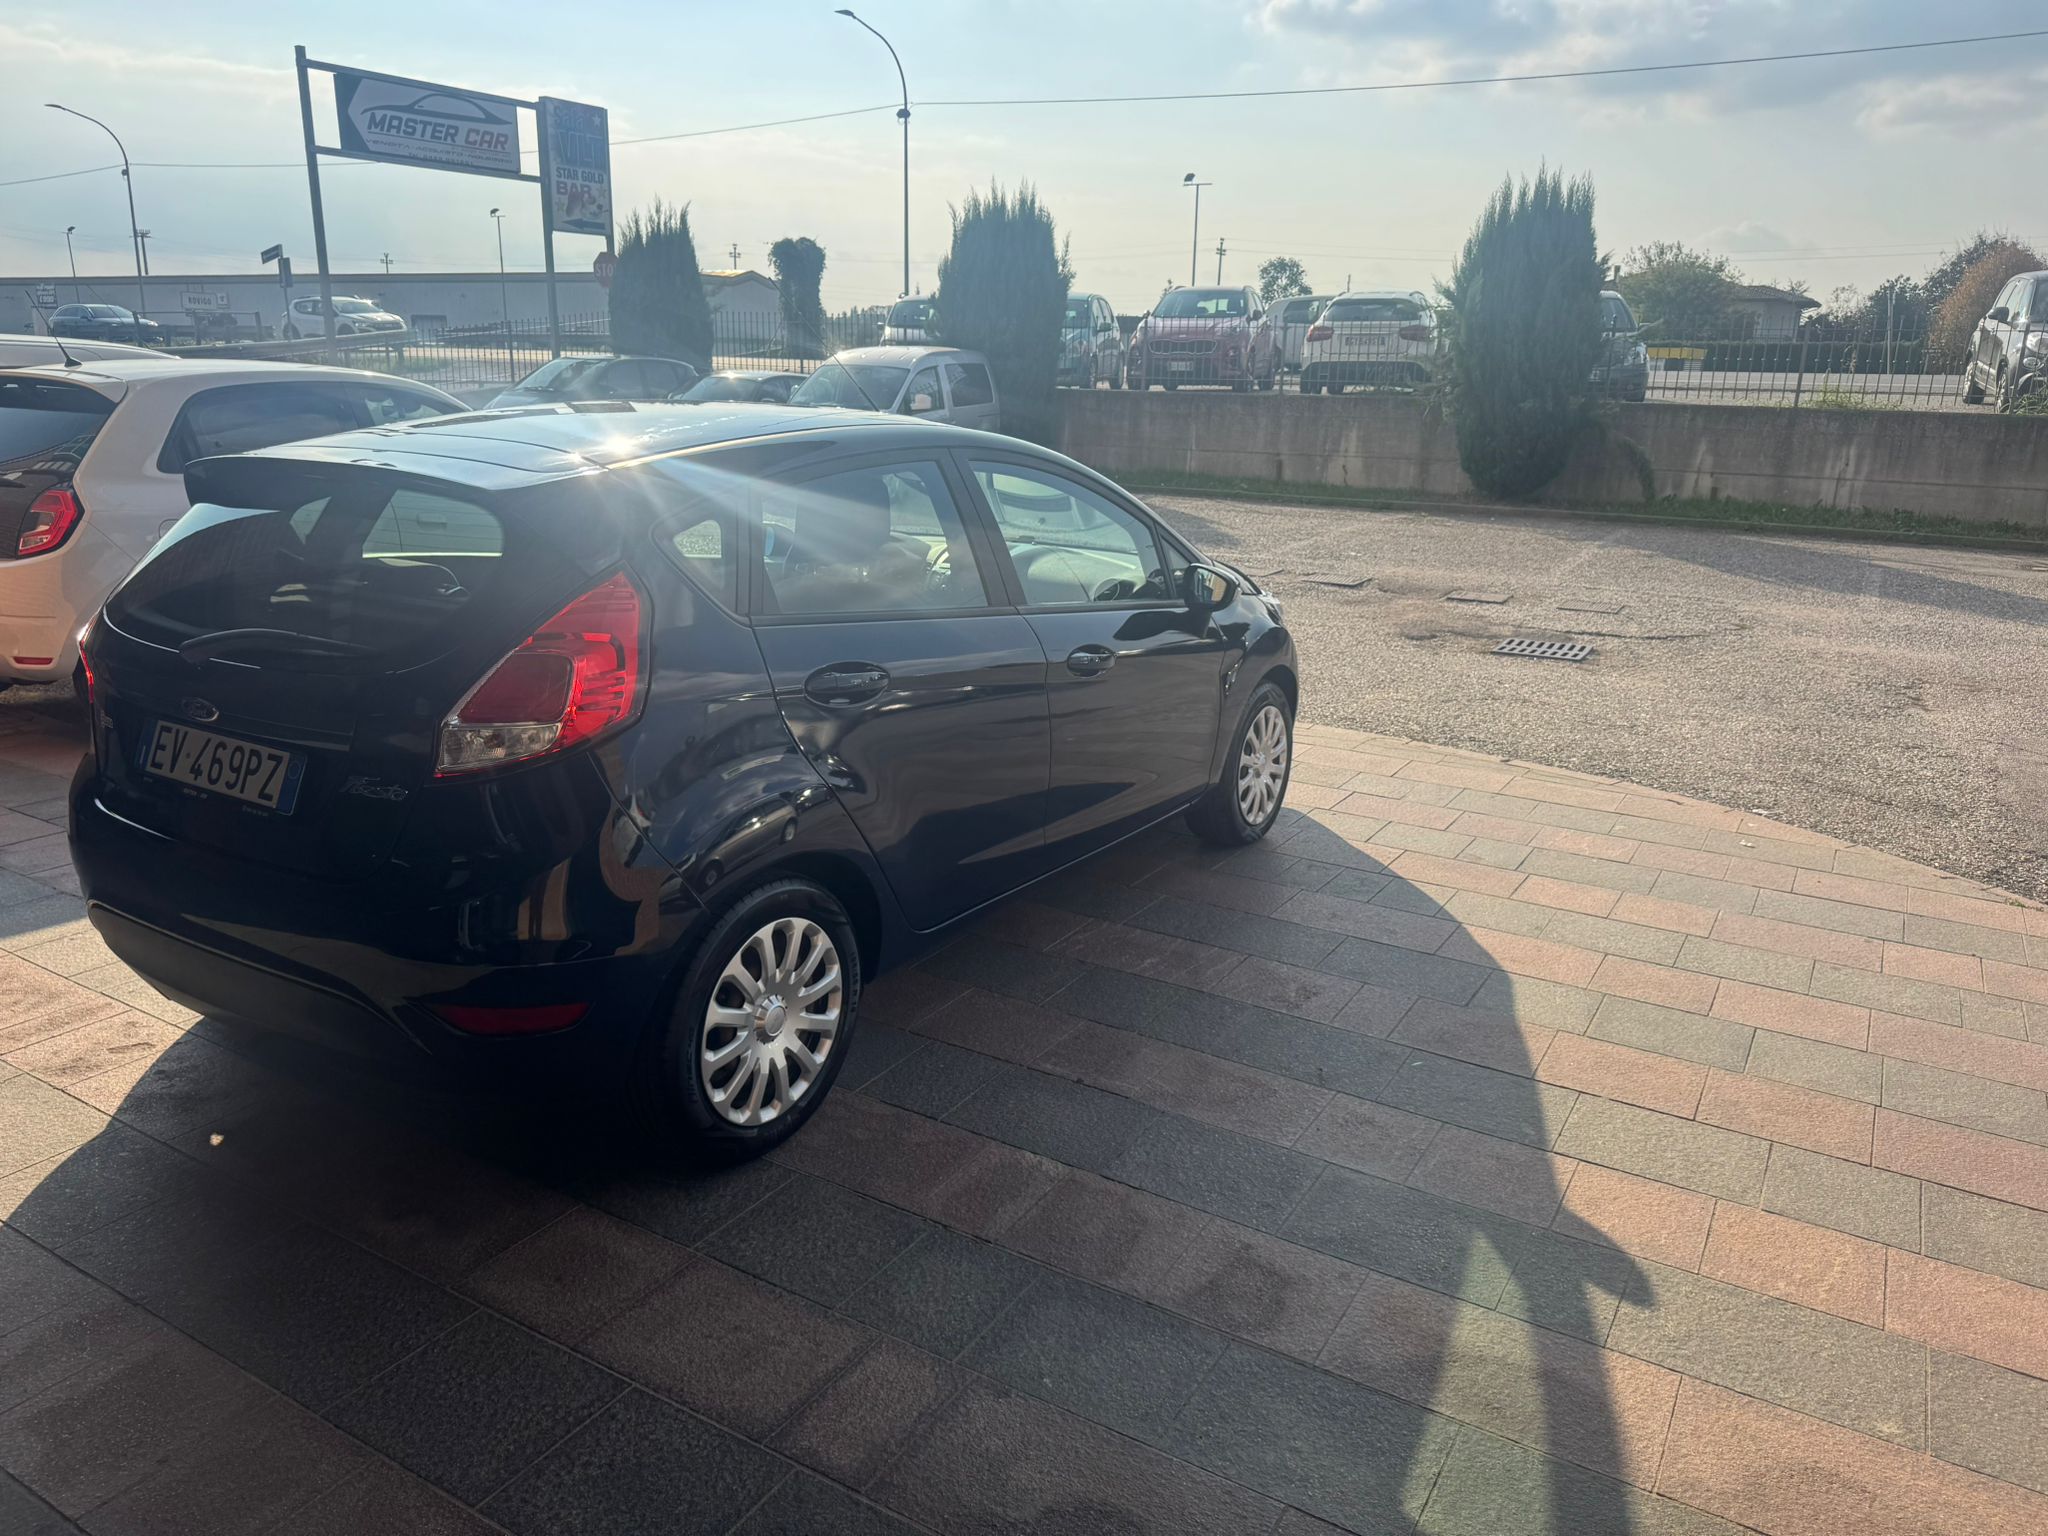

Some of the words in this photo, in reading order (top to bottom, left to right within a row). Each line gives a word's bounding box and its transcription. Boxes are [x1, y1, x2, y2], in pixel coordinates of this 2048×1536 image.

[367, 112, 459, 143] MASTER
[464, 128, 509, 150] CAR
[556, 166, 579, 180] STAR
[581, 170, 604, 184] GOLD
[556, 181, 592, 199] BAR
[595, 263, 617, 277] STO
